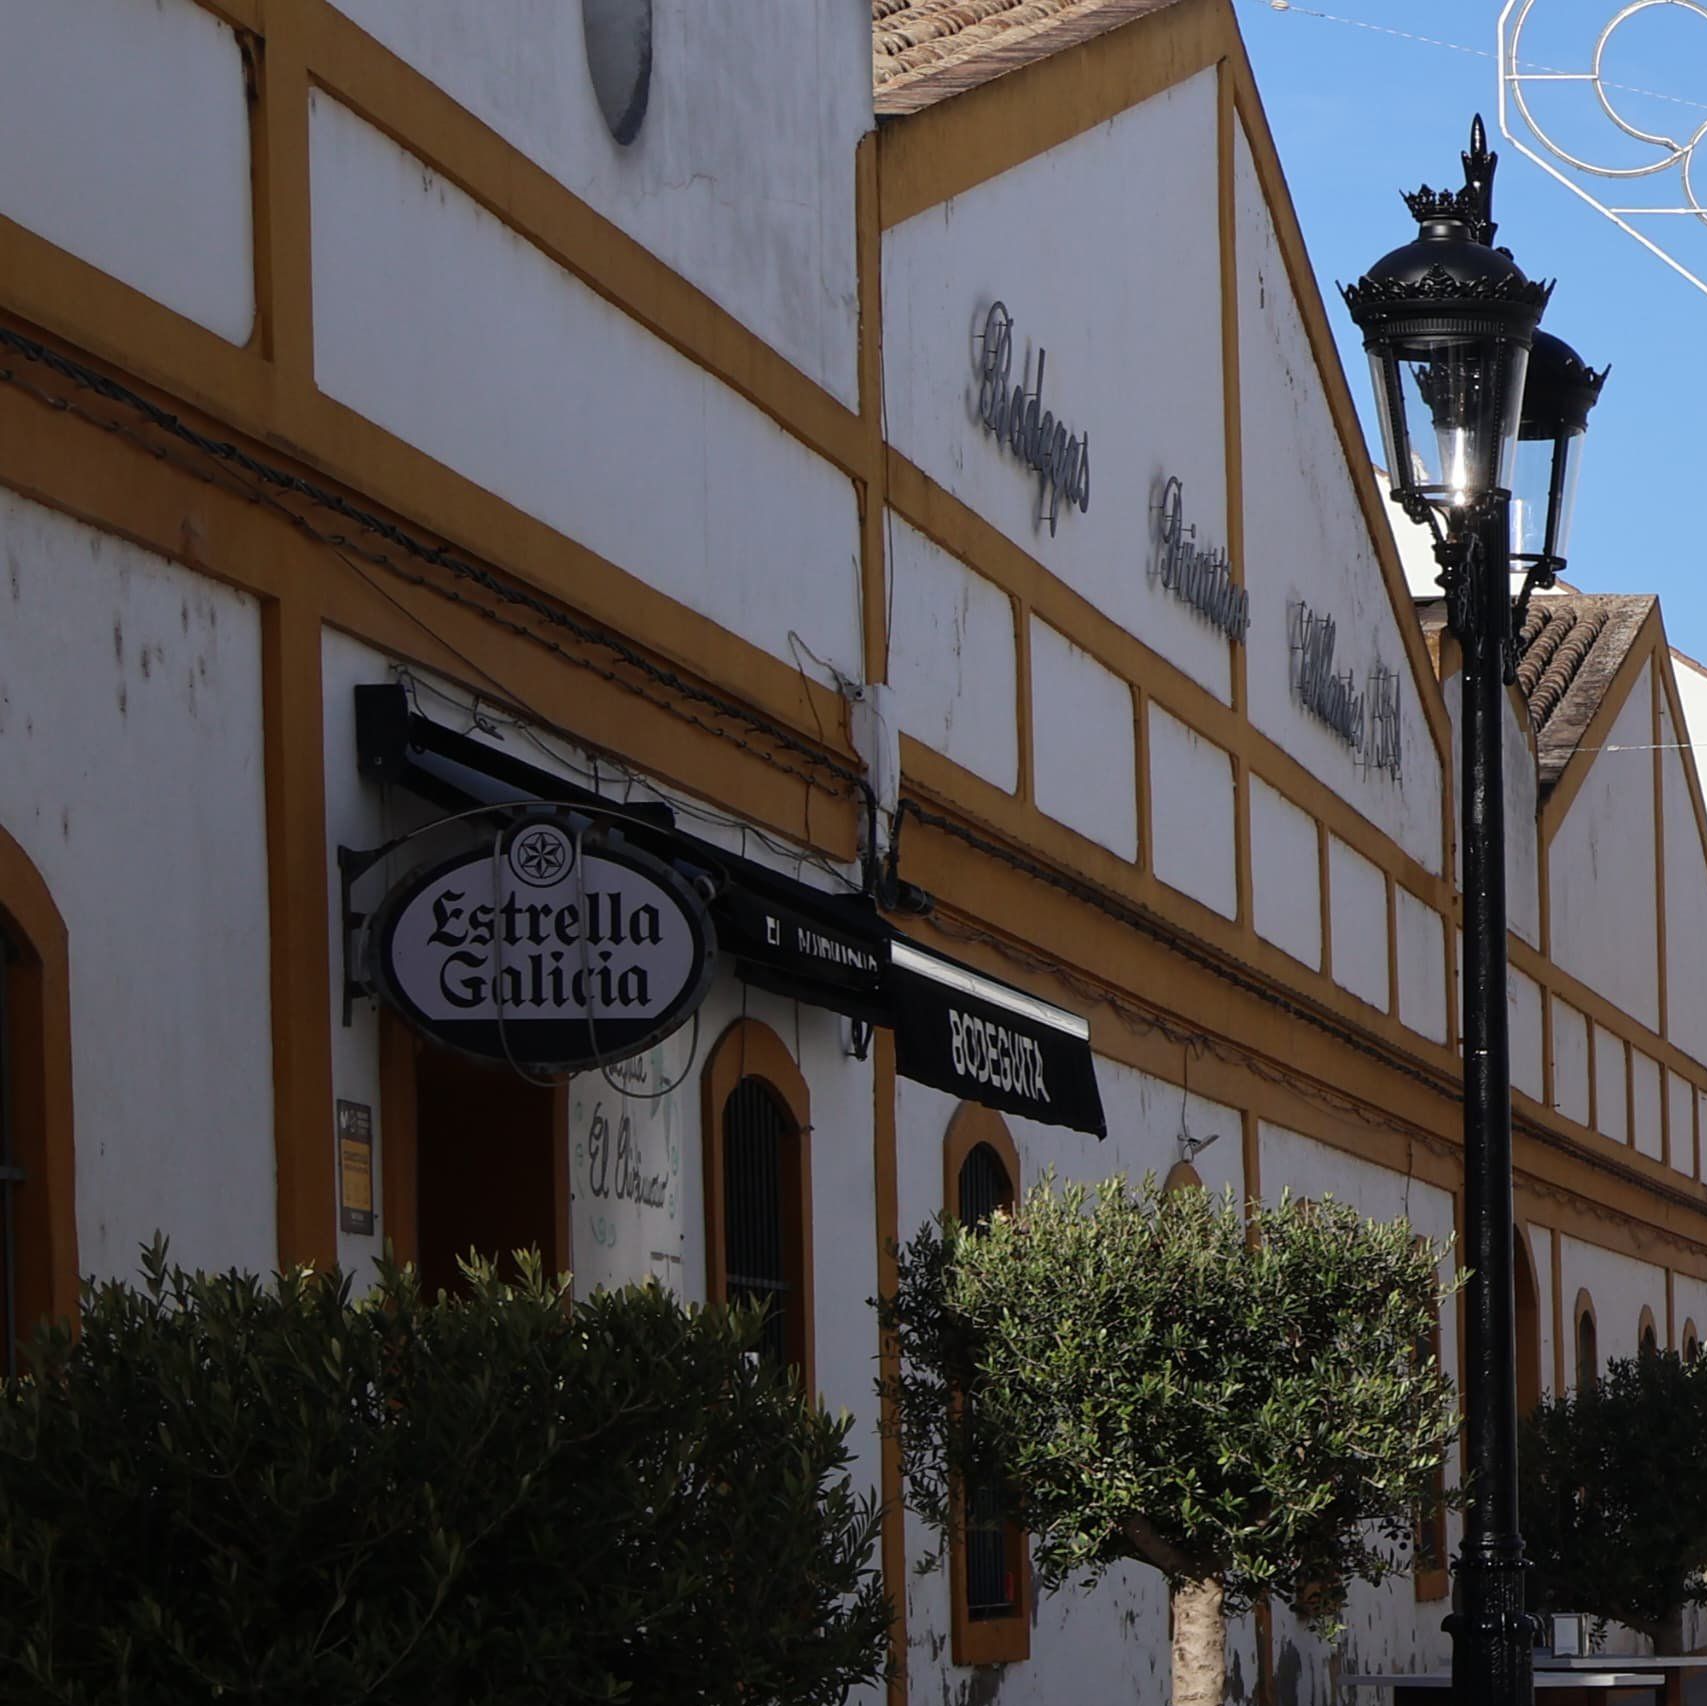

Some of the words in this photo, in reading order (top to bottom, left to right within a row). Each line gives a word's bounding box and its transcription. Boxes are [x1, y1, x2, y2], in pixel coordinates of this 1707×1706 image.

[979, 300, 1090, 539] Bodegas
[426, 888, 664, 947] Estrella
[439, 950, 653, 1009] Galicia
[948, 1008, 1052, 1103] BODEGUITA
